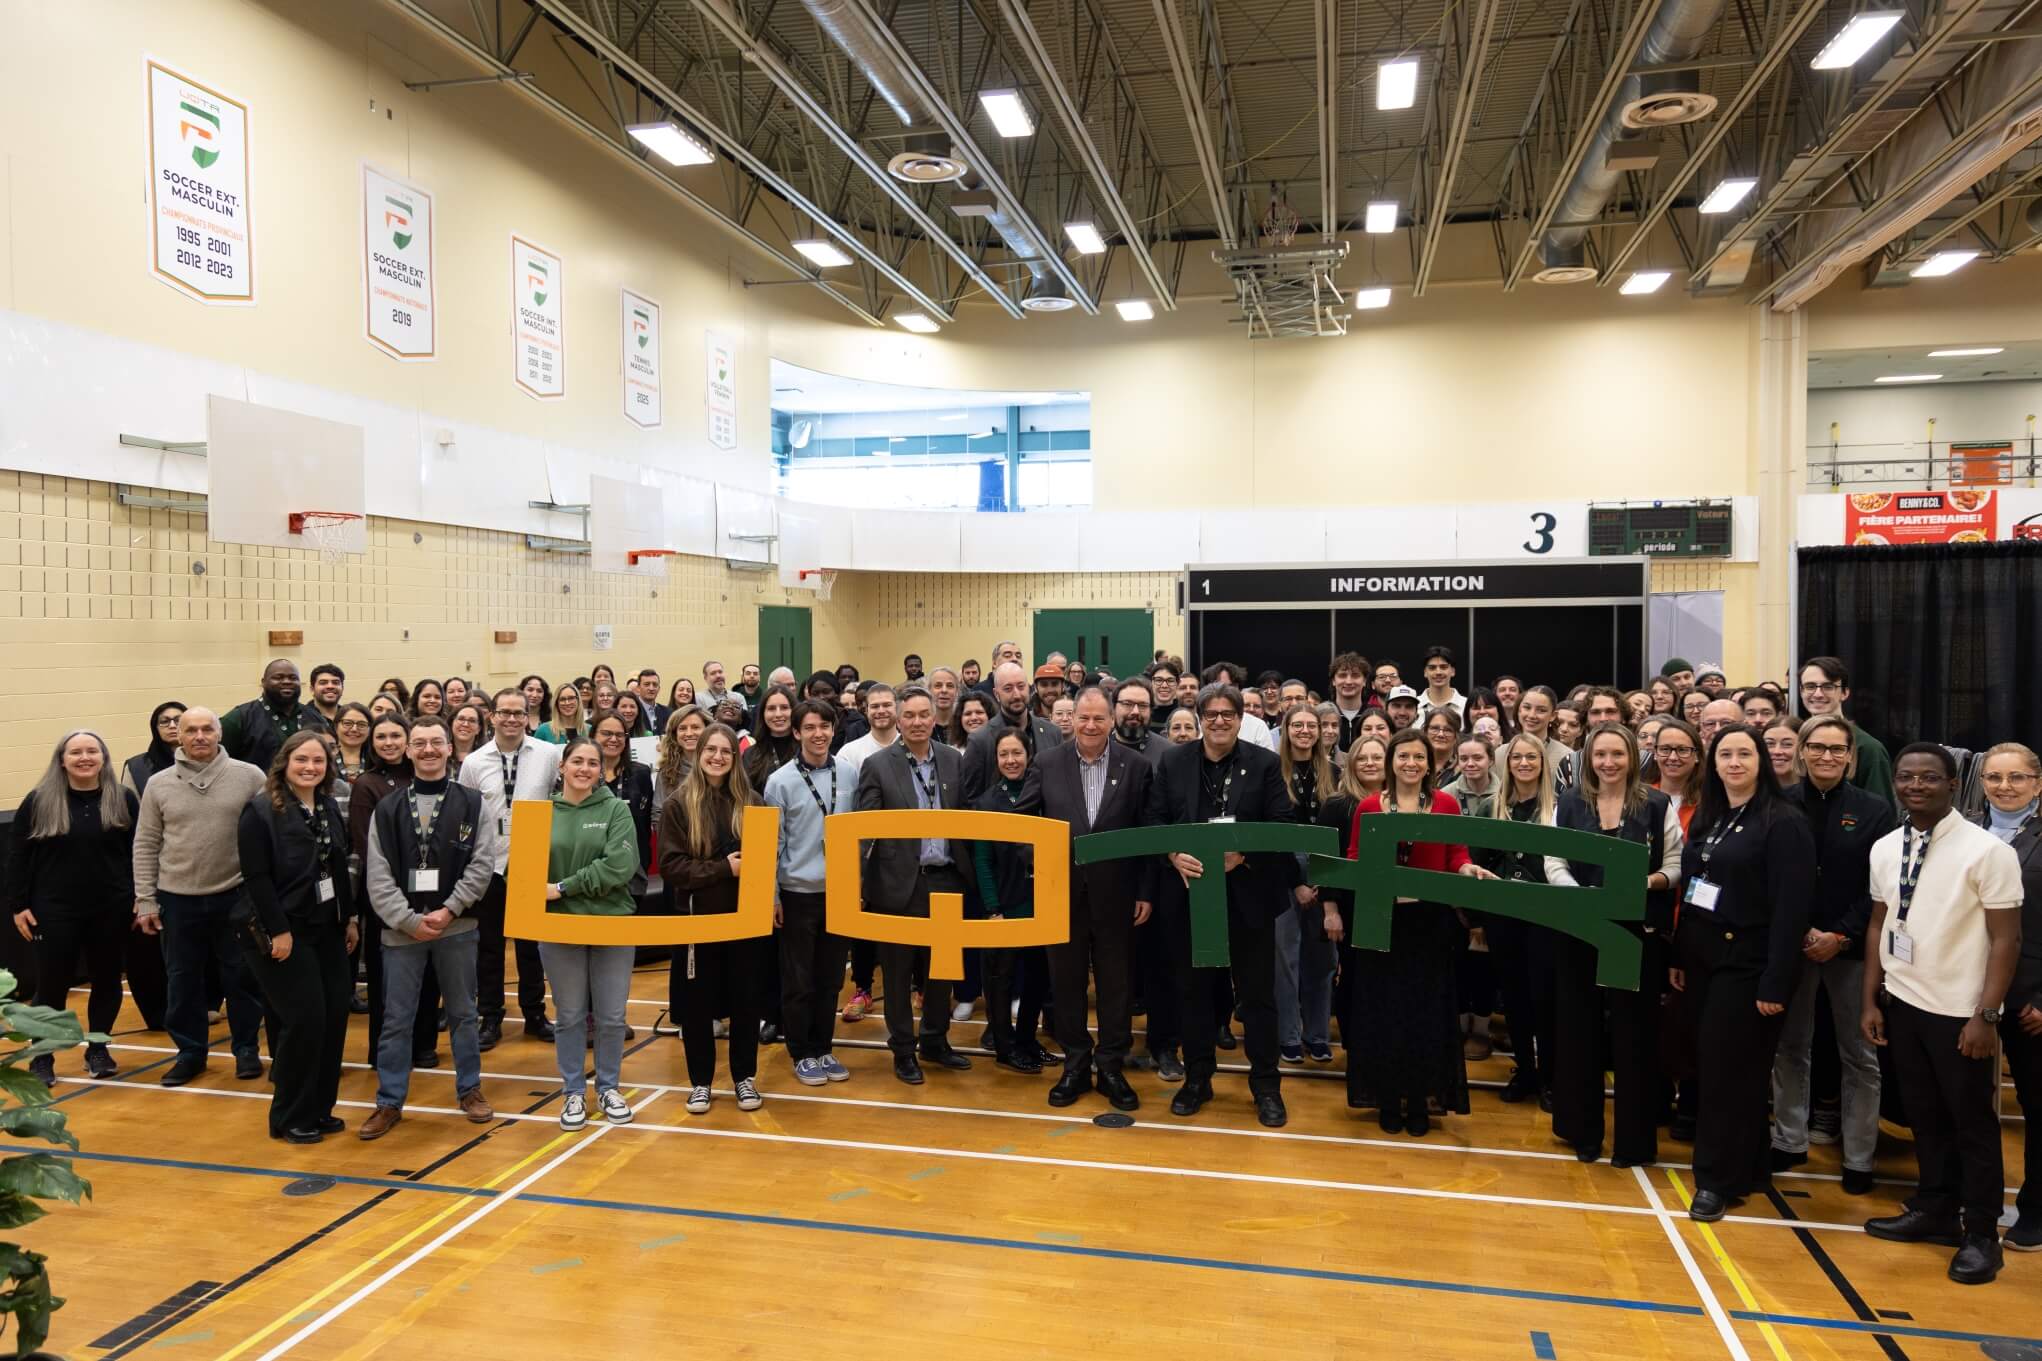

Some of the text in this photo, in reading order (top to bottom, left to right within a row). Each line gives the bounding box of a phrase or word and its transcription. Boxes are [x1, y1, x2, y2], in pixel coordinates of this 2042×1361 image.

[163, 169, 240, 208] SOCCER EXT.
[171, 185, 234, 218] MASCULIN
[176, 226, 231, 257] 1995 2001
[176, 249, 233, 279] 2012 2023
[373, 252, 426, 280] SOCCER EXT.
[379, 265, 422, 288] MASCULIN
[392, 308, 412, 327] 2019
[520, 307, 545, 322] SOCCER
[523, 318, 555, 336] MASCULIN
[630, 361, 655, 376] MASCULIN
[1523, 512, 1557, 554] 3
[1202, 579, 1211, 596] 1
[1330, 575, 1485, 593] INFORMATION
